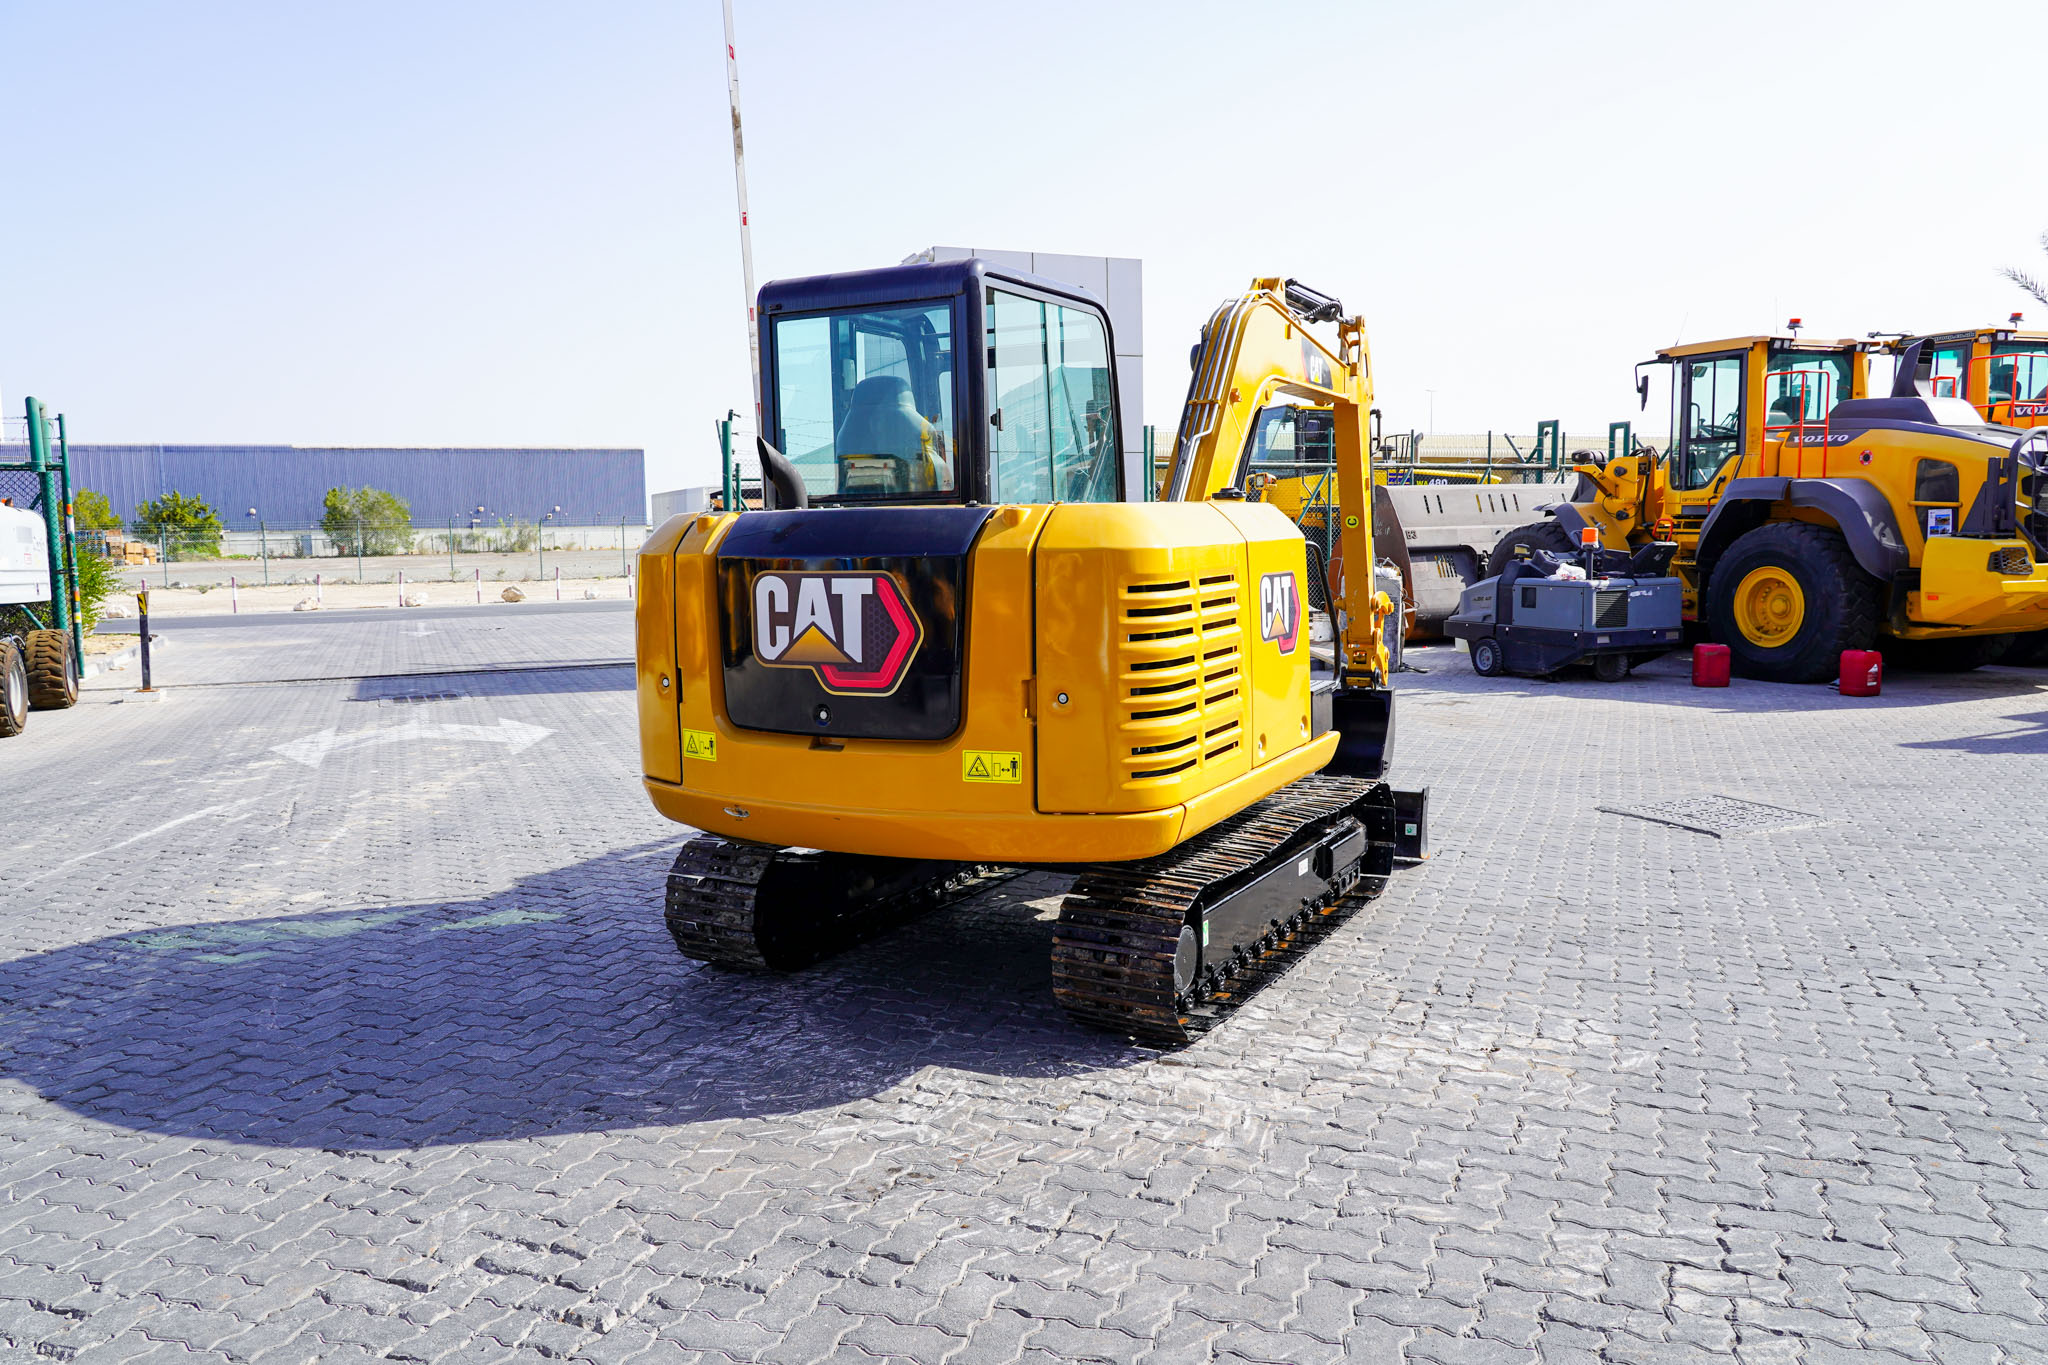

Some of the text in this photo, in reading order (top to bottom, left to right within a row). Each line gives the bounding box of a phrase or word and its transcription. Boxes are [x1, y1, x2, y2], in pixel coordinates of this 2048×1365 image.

[1793, 434, 1849, 443] VOLVO
[756, 575, 873, 663] CAT
[1261, 575, 1292, 639] CAT
